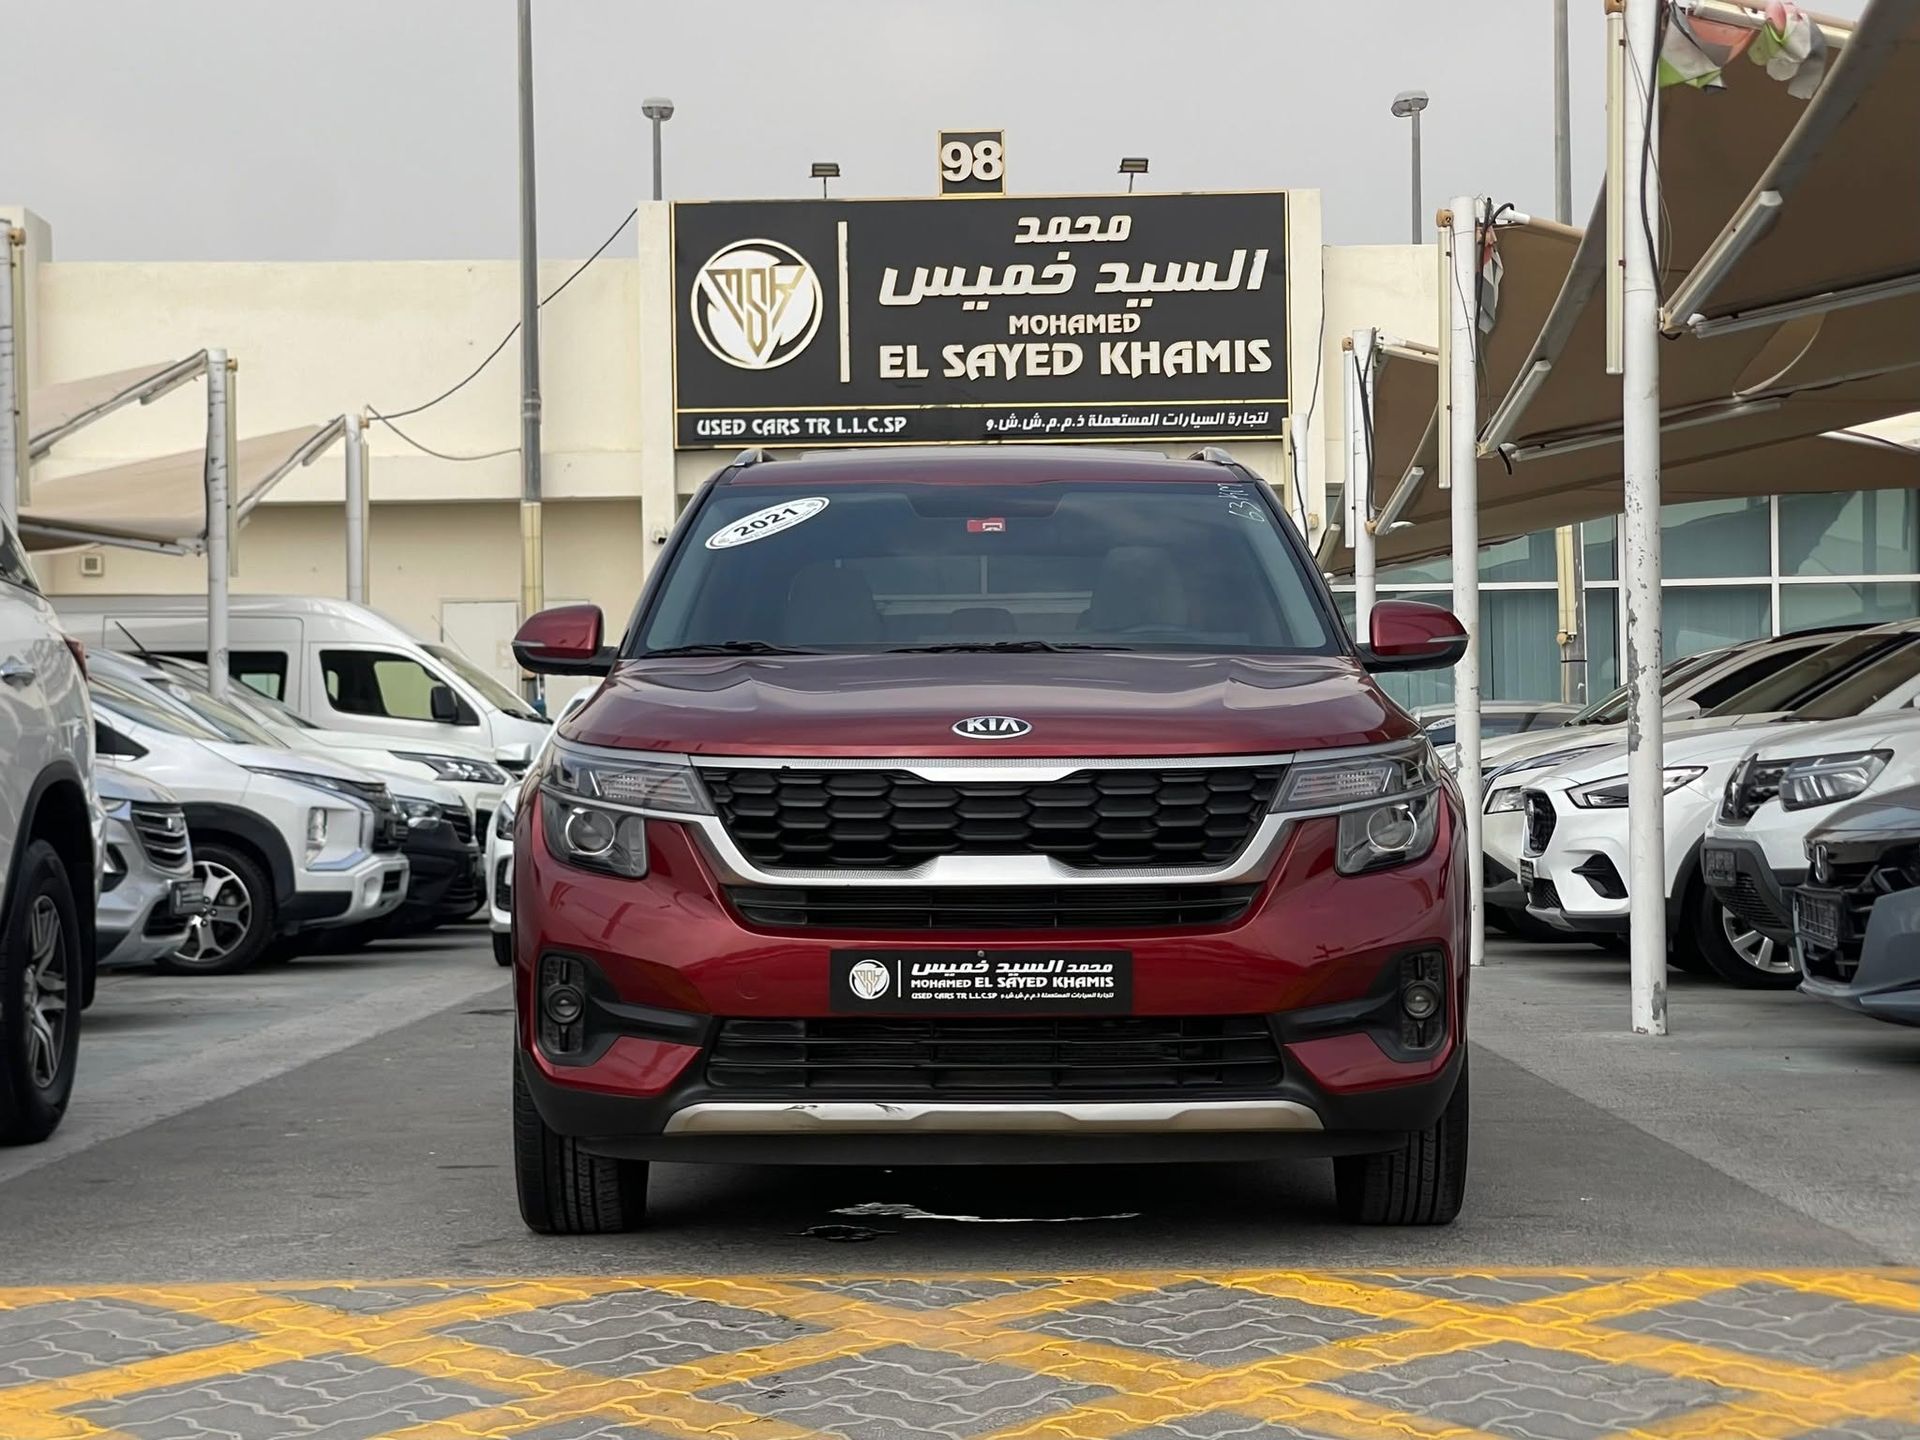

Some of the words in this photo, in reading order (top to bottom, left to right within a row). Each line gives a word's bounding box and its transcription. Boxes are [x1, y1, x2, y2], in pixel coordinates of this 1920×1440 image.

[940, 140, 1004, 182] 98
[1014, 215, 1133, 244] محمد
[878, 251, 1077, 311] خميس
[1094, 248, 1270, 308] السيد
[1009, 312, 1141, 336] MOHAMED
[879, 344, 929, 379] EL
[942, 341, 1084, 381] SAYED
[1100, 339, 1272, 379] KHAMIS
[697, 419, 746, 435] USED
[751, 418, 800, 436] CARS
[805, 417, 831, 435] TR
[836, 416, 907, 434] L.L.C.SP
[1088, 412, 1159, 427] المستعملة
[1162, 411, 1225, 429] السيارات
[1227, 411, 1269, 427] لتجارة
[733, 508, 798, 536] 2021
[966, 718, 1020, 732] KIA
[911, 960, 989, 976] خميس
[996, 960, 1064, 976] السيد
[1066, 963, 1113, 973] محمد
[911, 979, 972, 989] MOHAMED
[975, 977, 993, 988] EL
[997, 977, 1048, 989] SAYED
[1052, 976, 1114, 989] KHAMIS
[934, 992, 954, 1000] CARS
